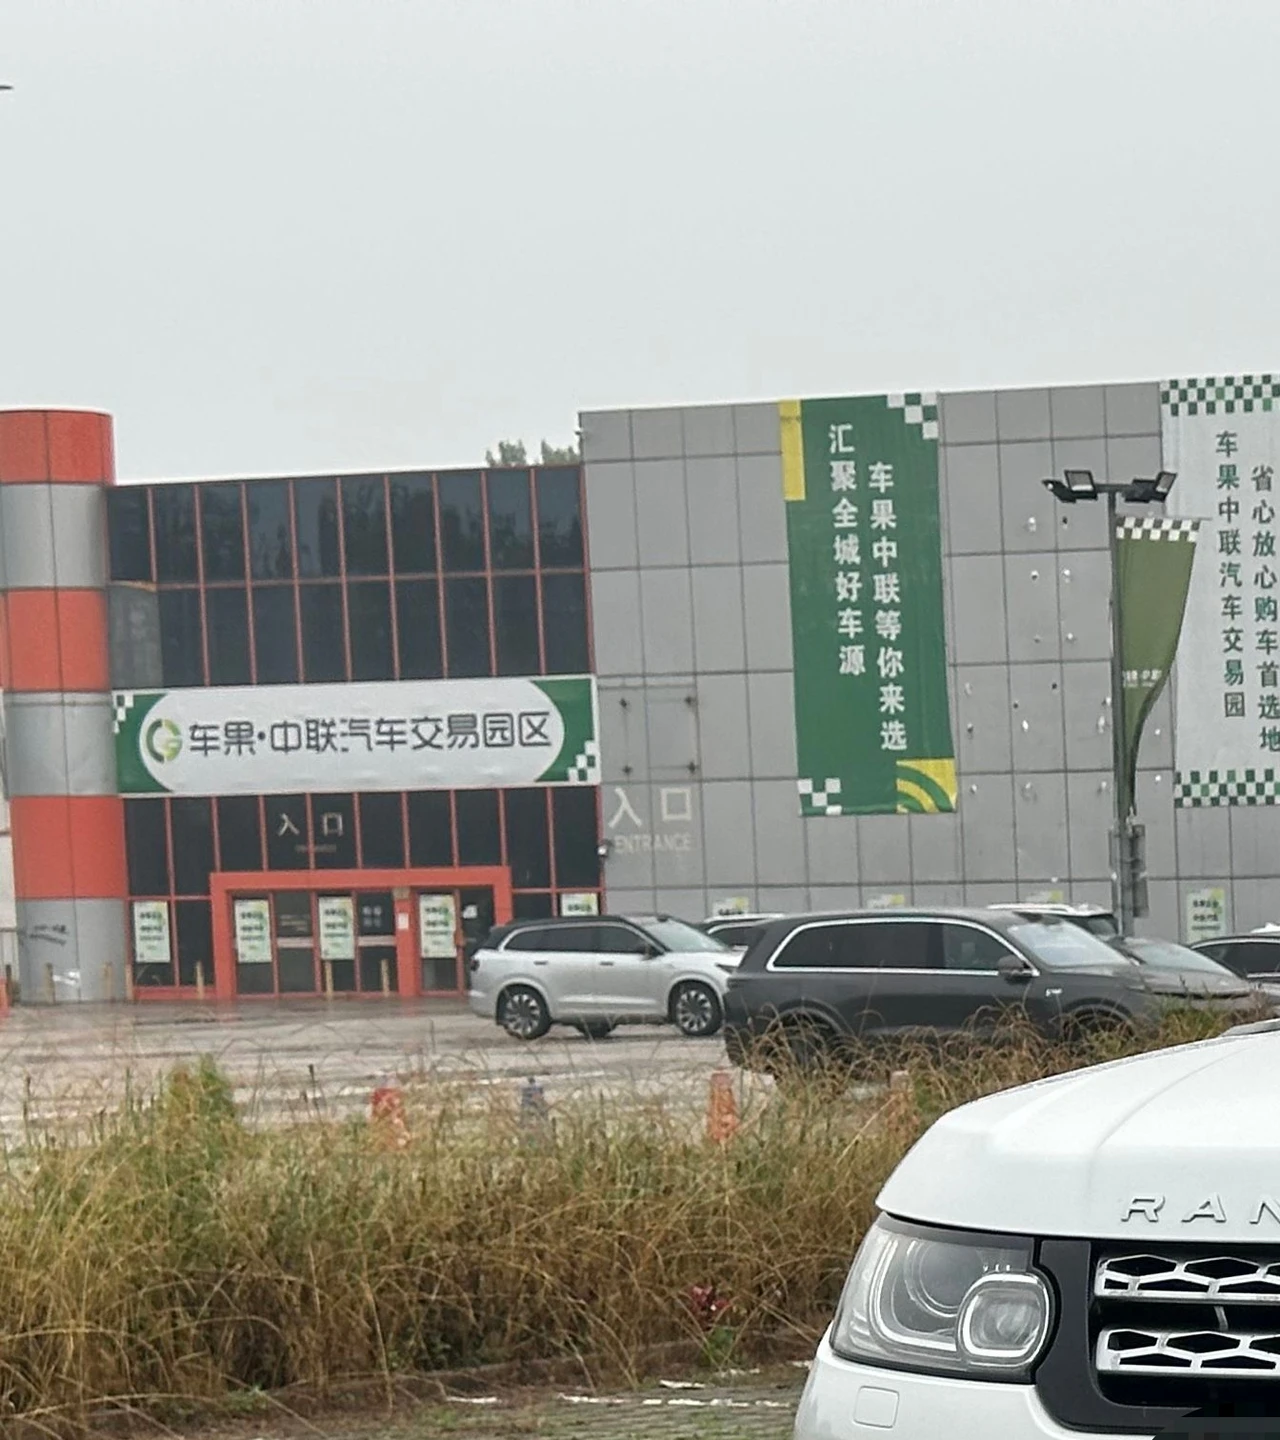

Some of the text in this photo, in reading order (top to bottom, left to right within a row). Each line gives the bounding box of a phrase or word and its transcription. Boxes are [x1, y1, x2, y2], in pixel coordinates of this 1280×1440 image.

[828, 423, 866, 676] 汇聚全城好车源
[868, 461, 907, 751] 车果中联等你来选
[1215, 430, 1246, 718] 车果中联汽车交易园
